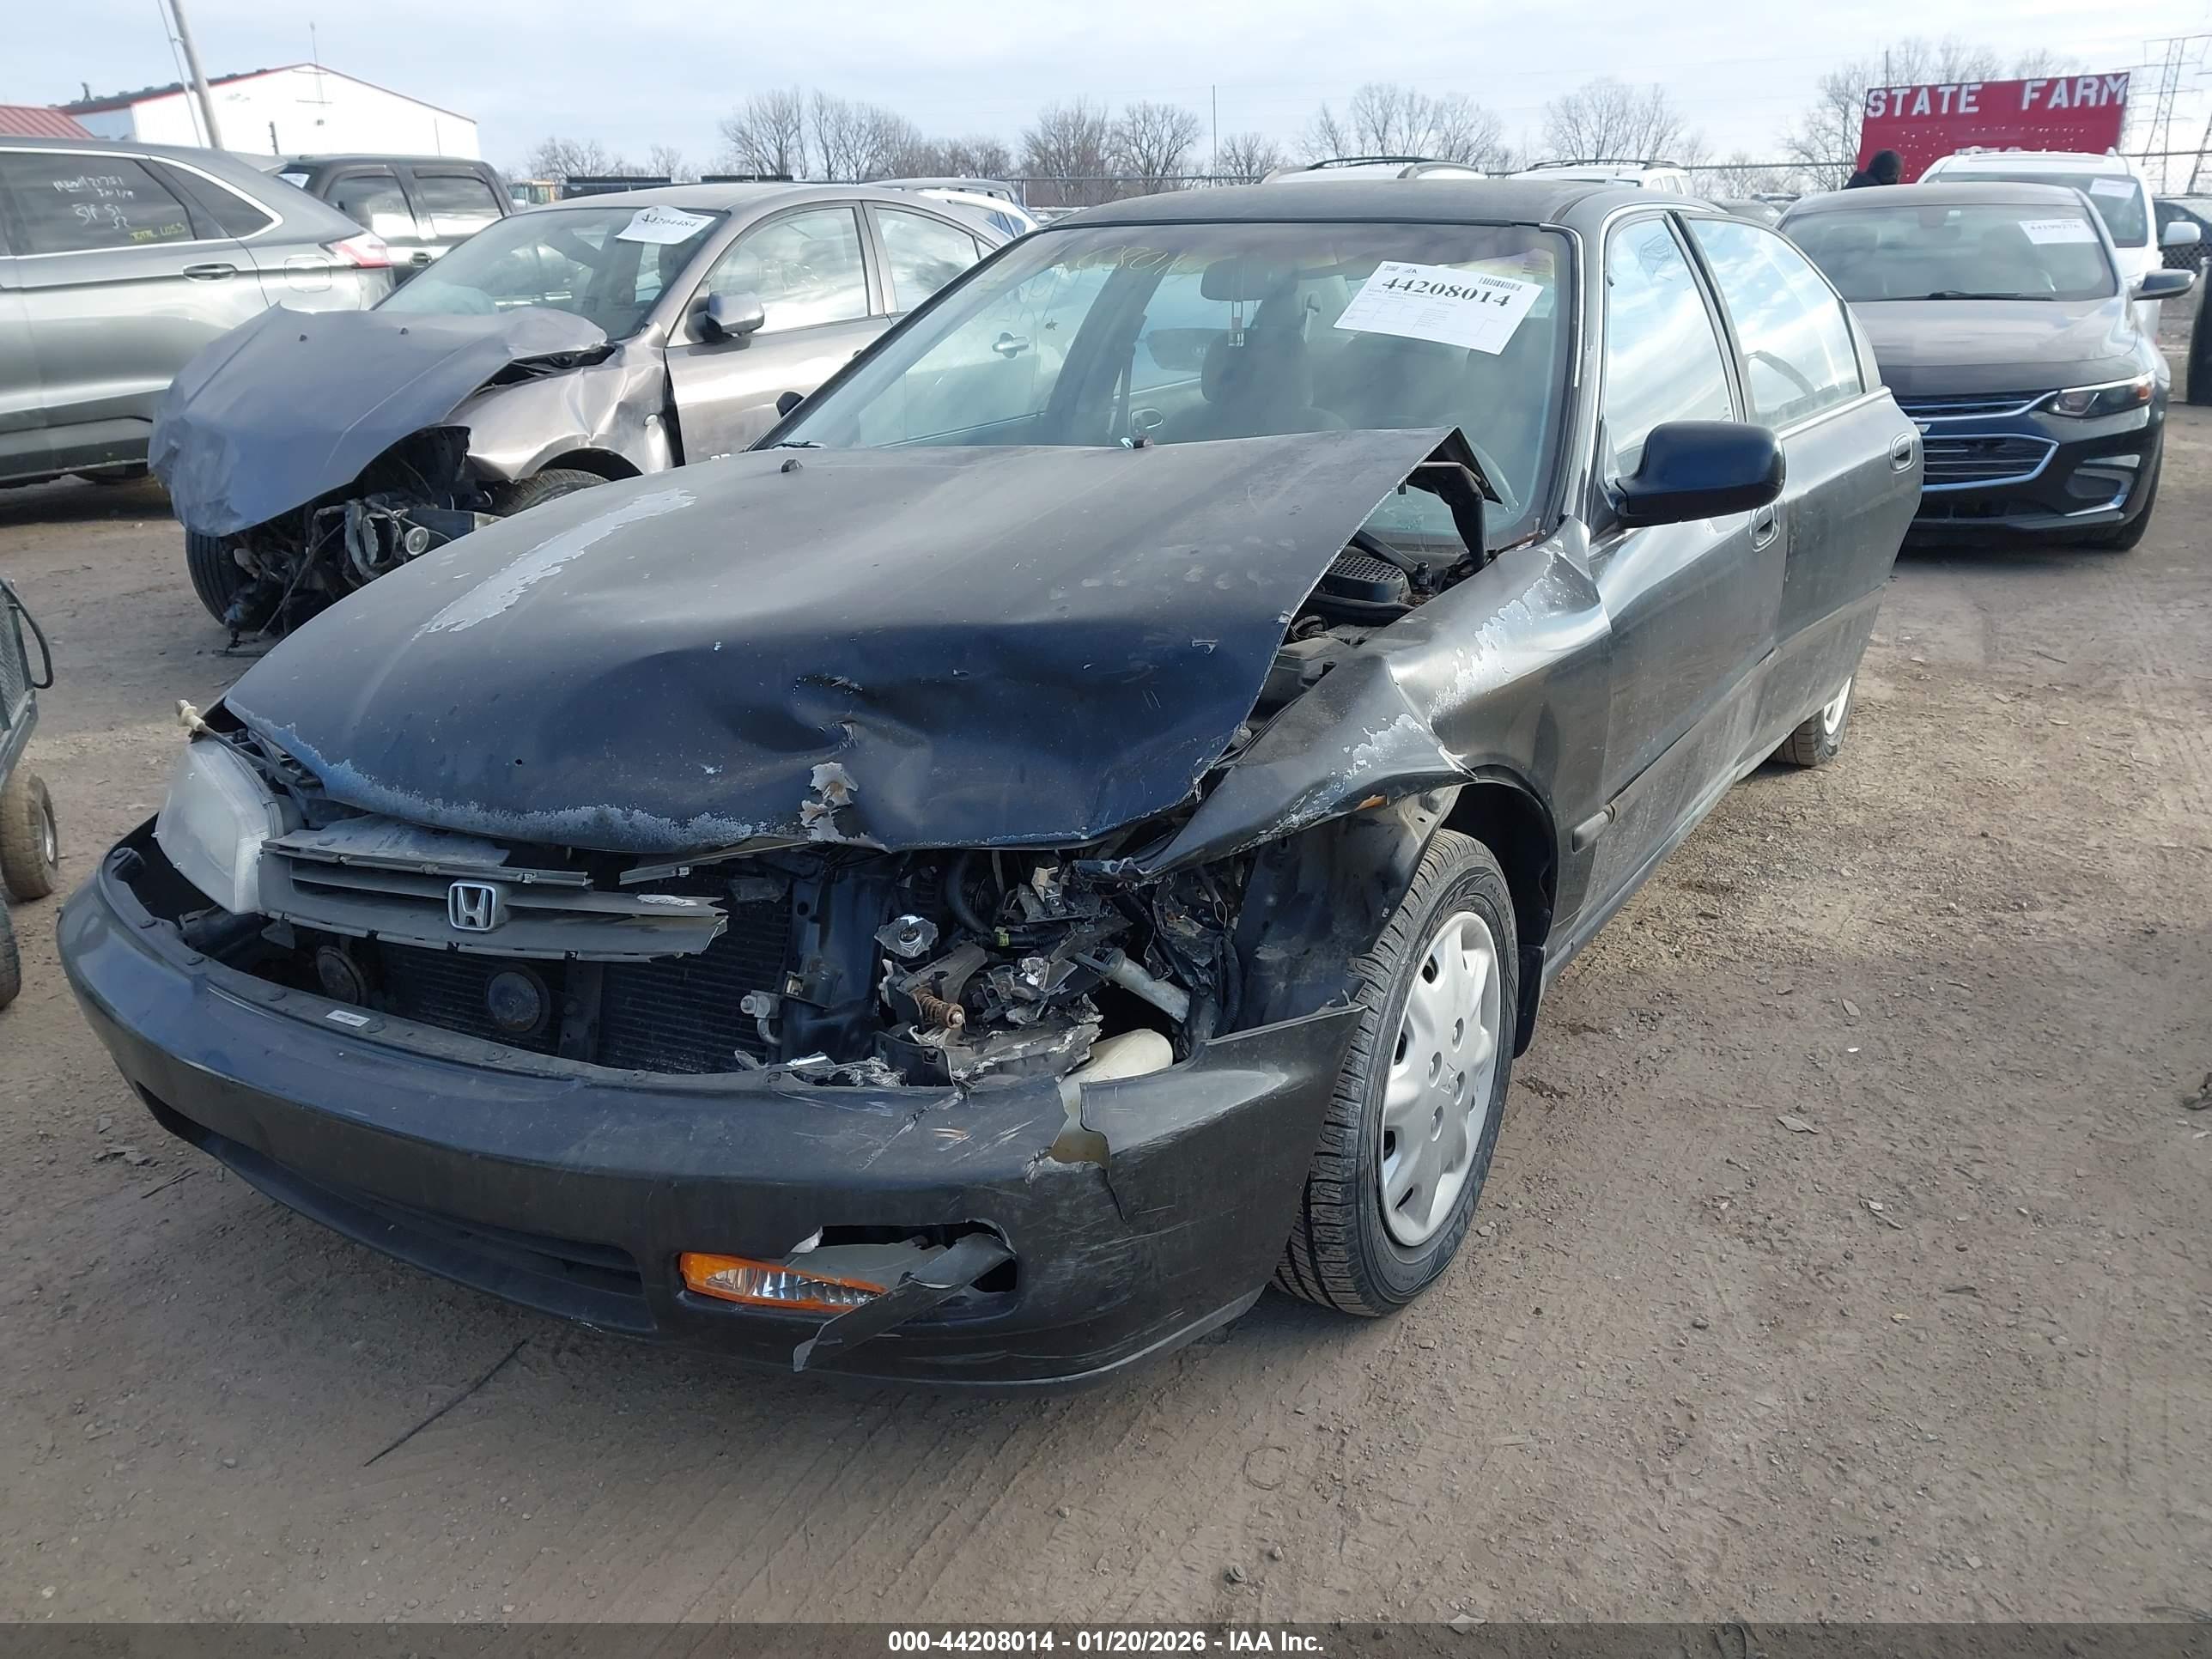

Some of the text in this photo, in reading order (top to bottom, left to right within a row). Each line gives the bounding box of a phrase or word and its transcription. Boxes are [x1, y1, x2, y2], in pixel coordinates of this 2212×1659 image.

[1866, 74, 2130, 118] STATE FARM
[159, 222, 186, 236] LOSS
[1382, 276, 1512, 307] 44208014
